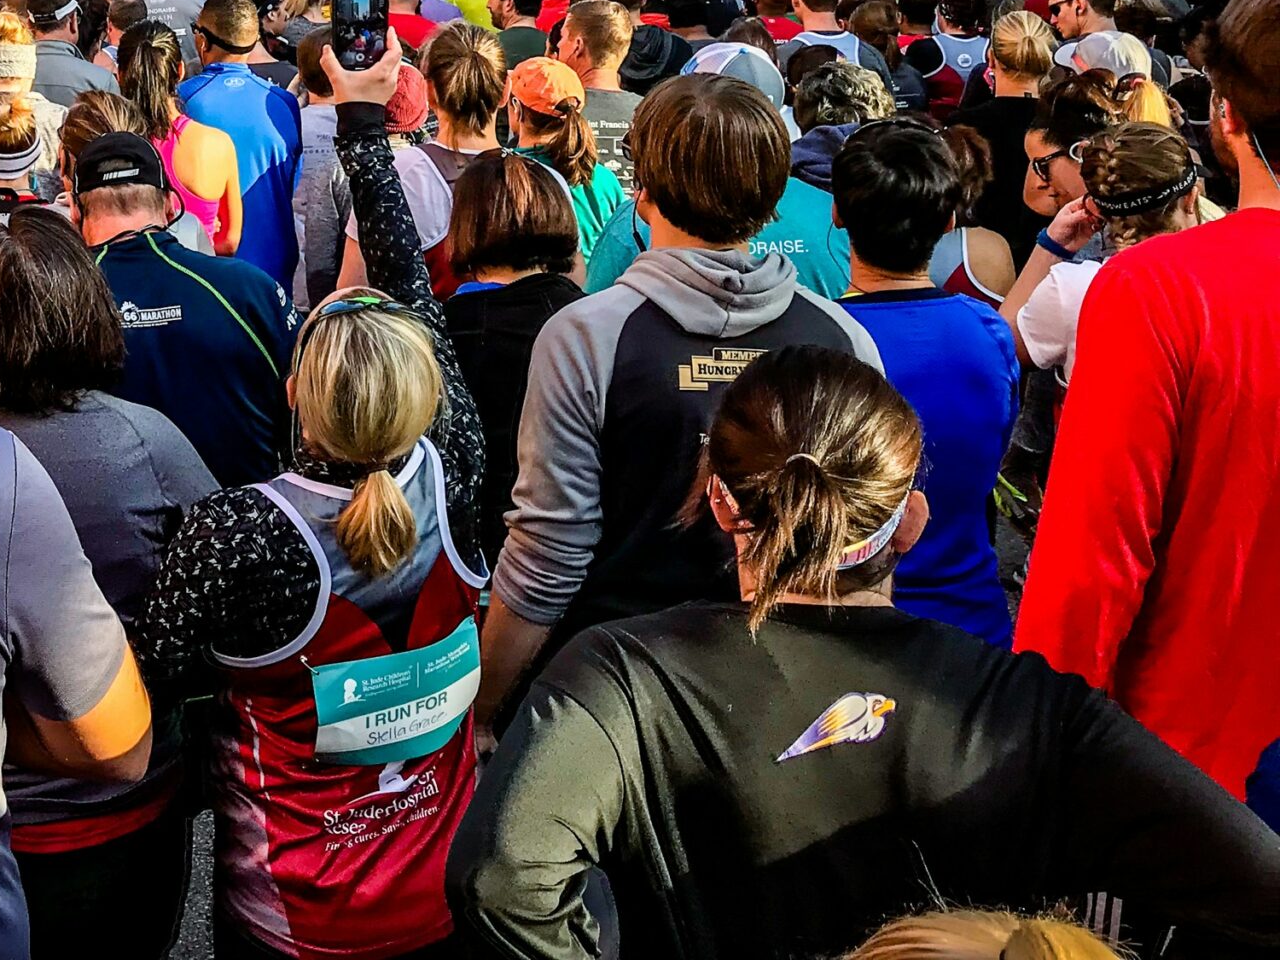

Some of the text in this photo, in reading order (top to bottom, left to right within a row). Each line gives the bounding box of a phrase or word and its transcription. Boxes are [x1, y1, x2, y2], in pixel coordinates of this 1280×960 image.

[600, 120, 629, 128] Francis
[748, 240, 809, 254] DRAISE.
[123, 308, 181, 321] 66 MARATHON
[366, 692, 448, 729] I RUN FOR
[323, 809, 344, 827] St.
